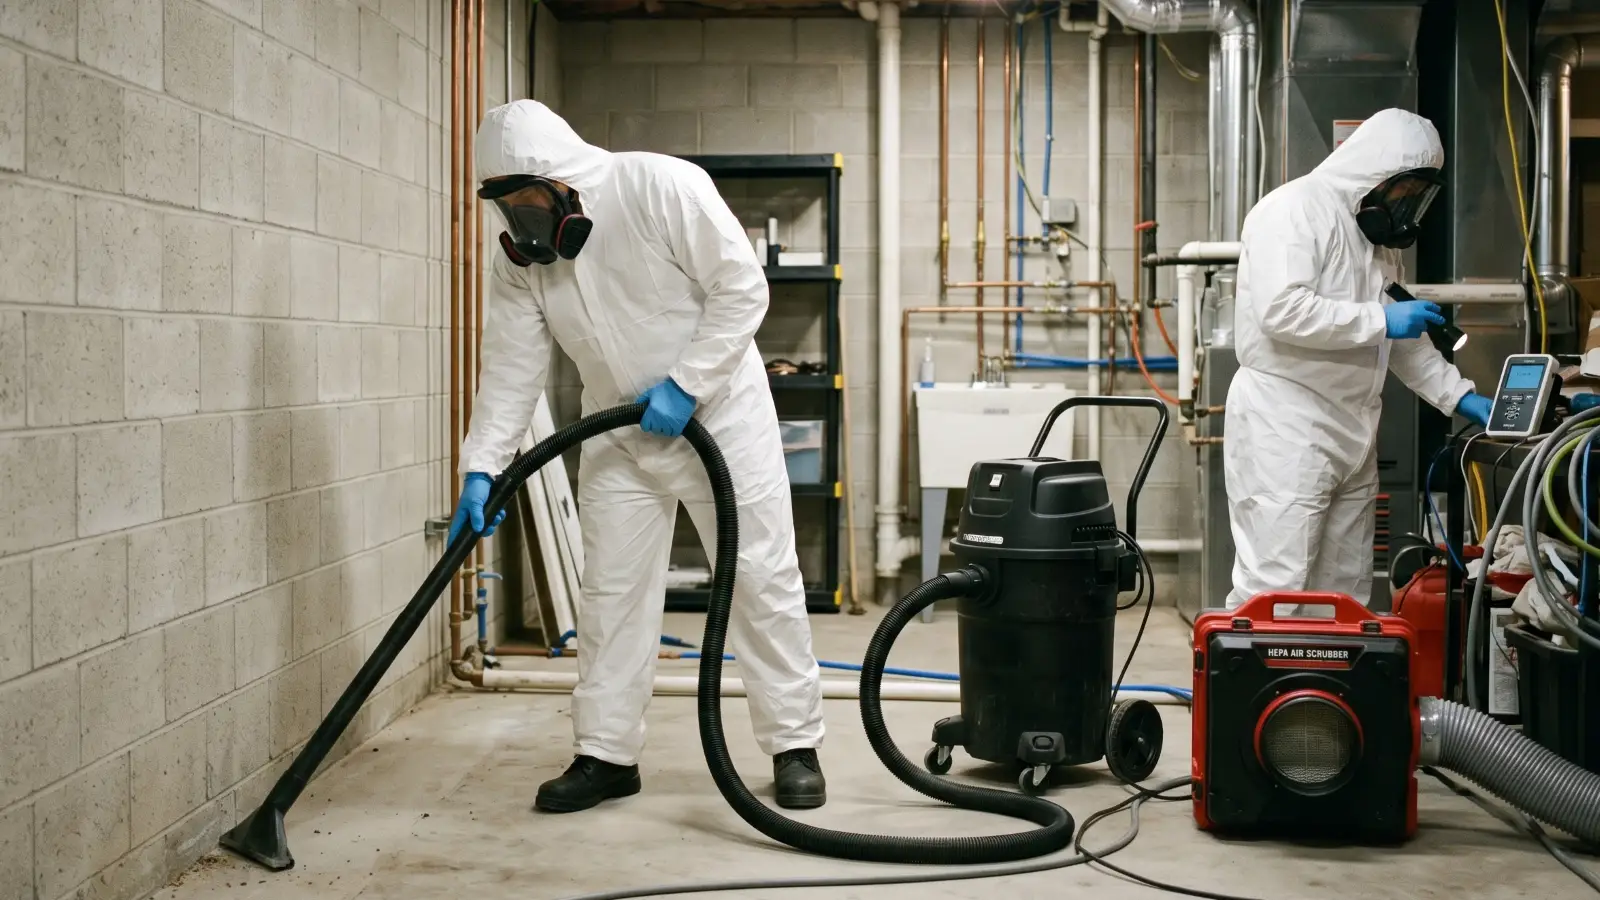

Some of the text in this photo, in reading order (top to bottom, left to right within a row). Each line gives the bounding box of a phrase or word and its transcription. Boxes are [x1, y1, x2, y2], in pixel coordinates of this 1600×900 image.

[1268, 648, 1349, 659] HEPA AIR SCRUBBER
